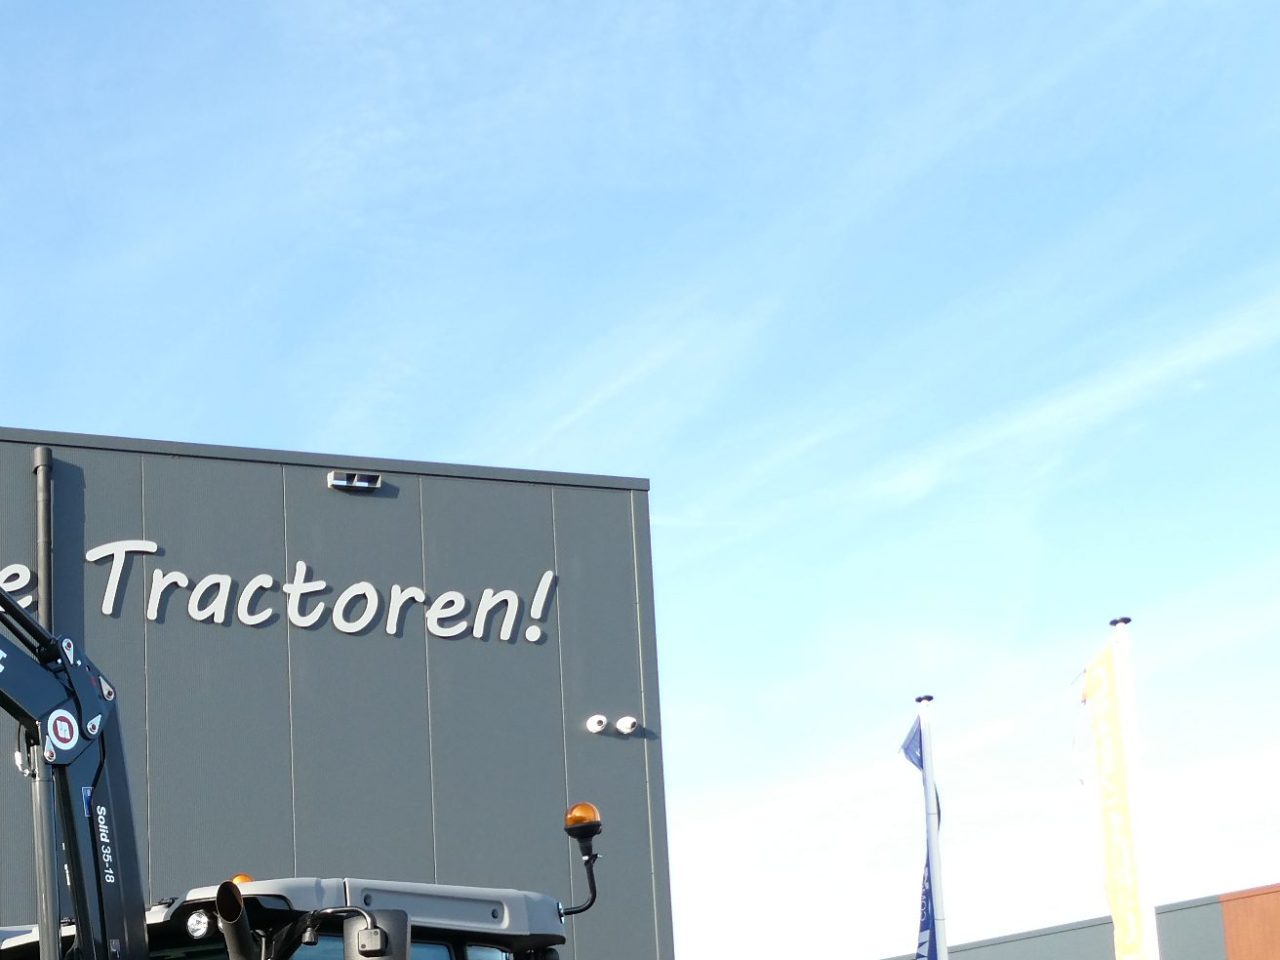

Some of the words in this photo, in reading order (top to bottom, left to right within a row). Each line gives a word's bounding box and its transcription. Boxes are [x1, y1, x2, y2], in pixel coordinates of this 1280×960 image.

[85, 539, 555, 642] Tractoren!
[96, 805, 110, 843] Solid
[101, 845, 115, 884] 35-18
